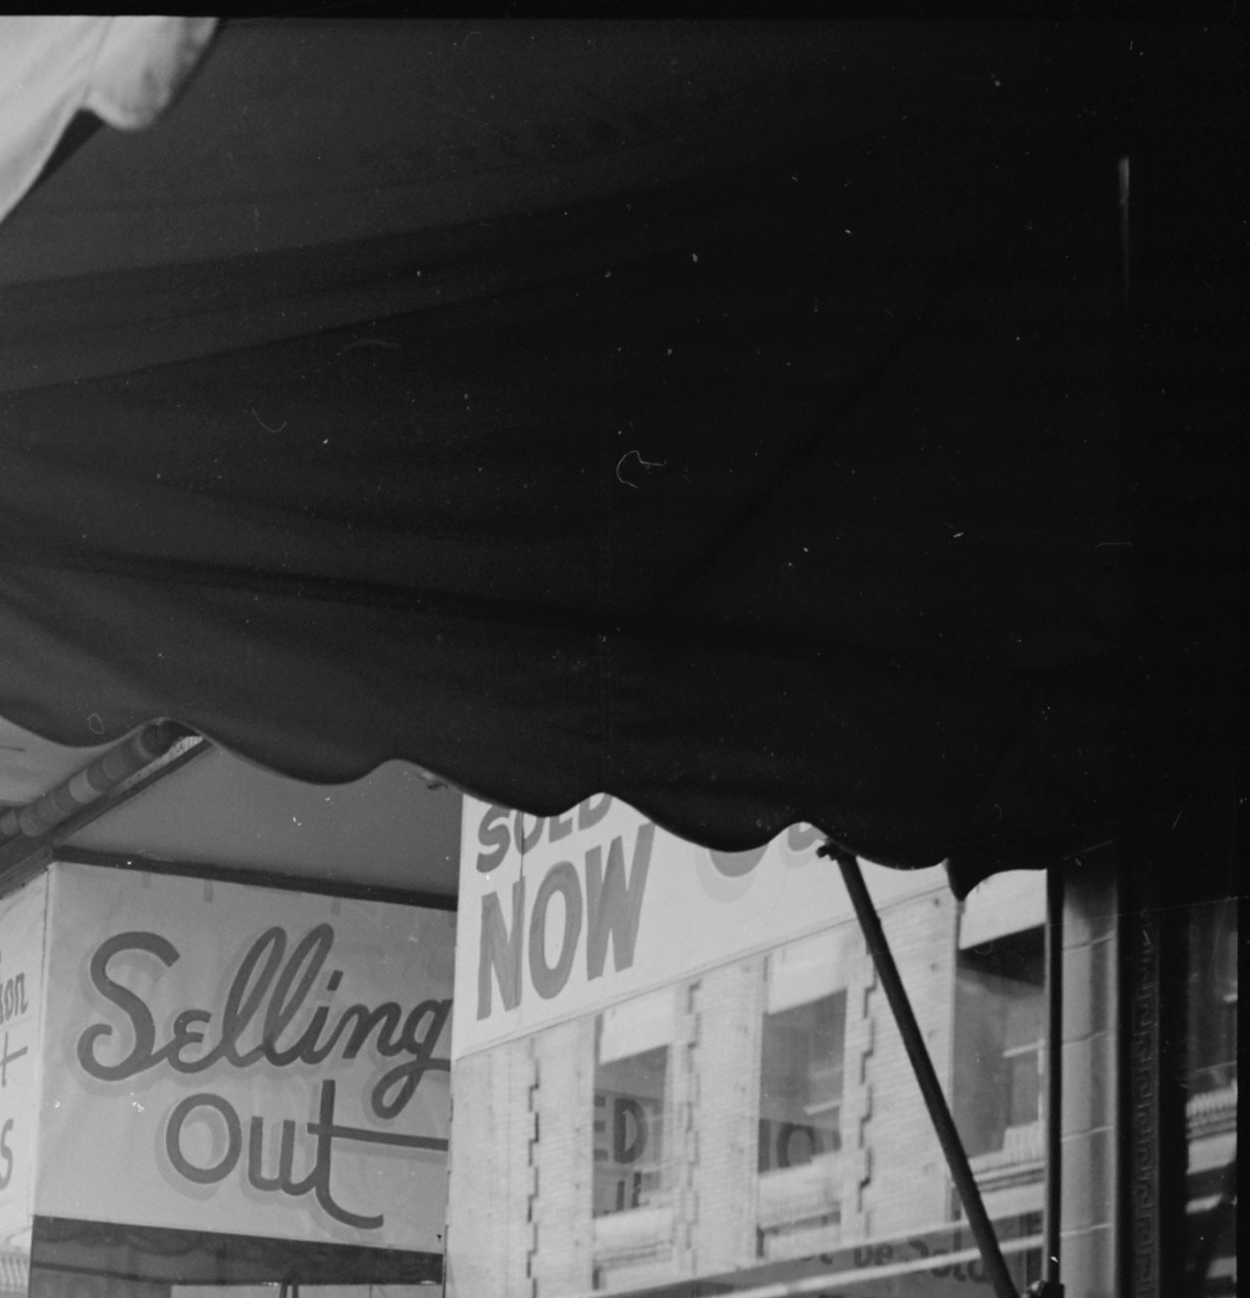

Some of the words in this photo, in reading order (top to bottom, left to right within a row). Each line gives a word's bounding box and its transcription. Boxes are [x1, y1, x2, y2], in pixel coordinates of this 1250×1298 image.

[476, 821, 657, 1021] NOW
[76, 922, 453, 1120] Selling
[165, 1078, 449, 1230] Out
